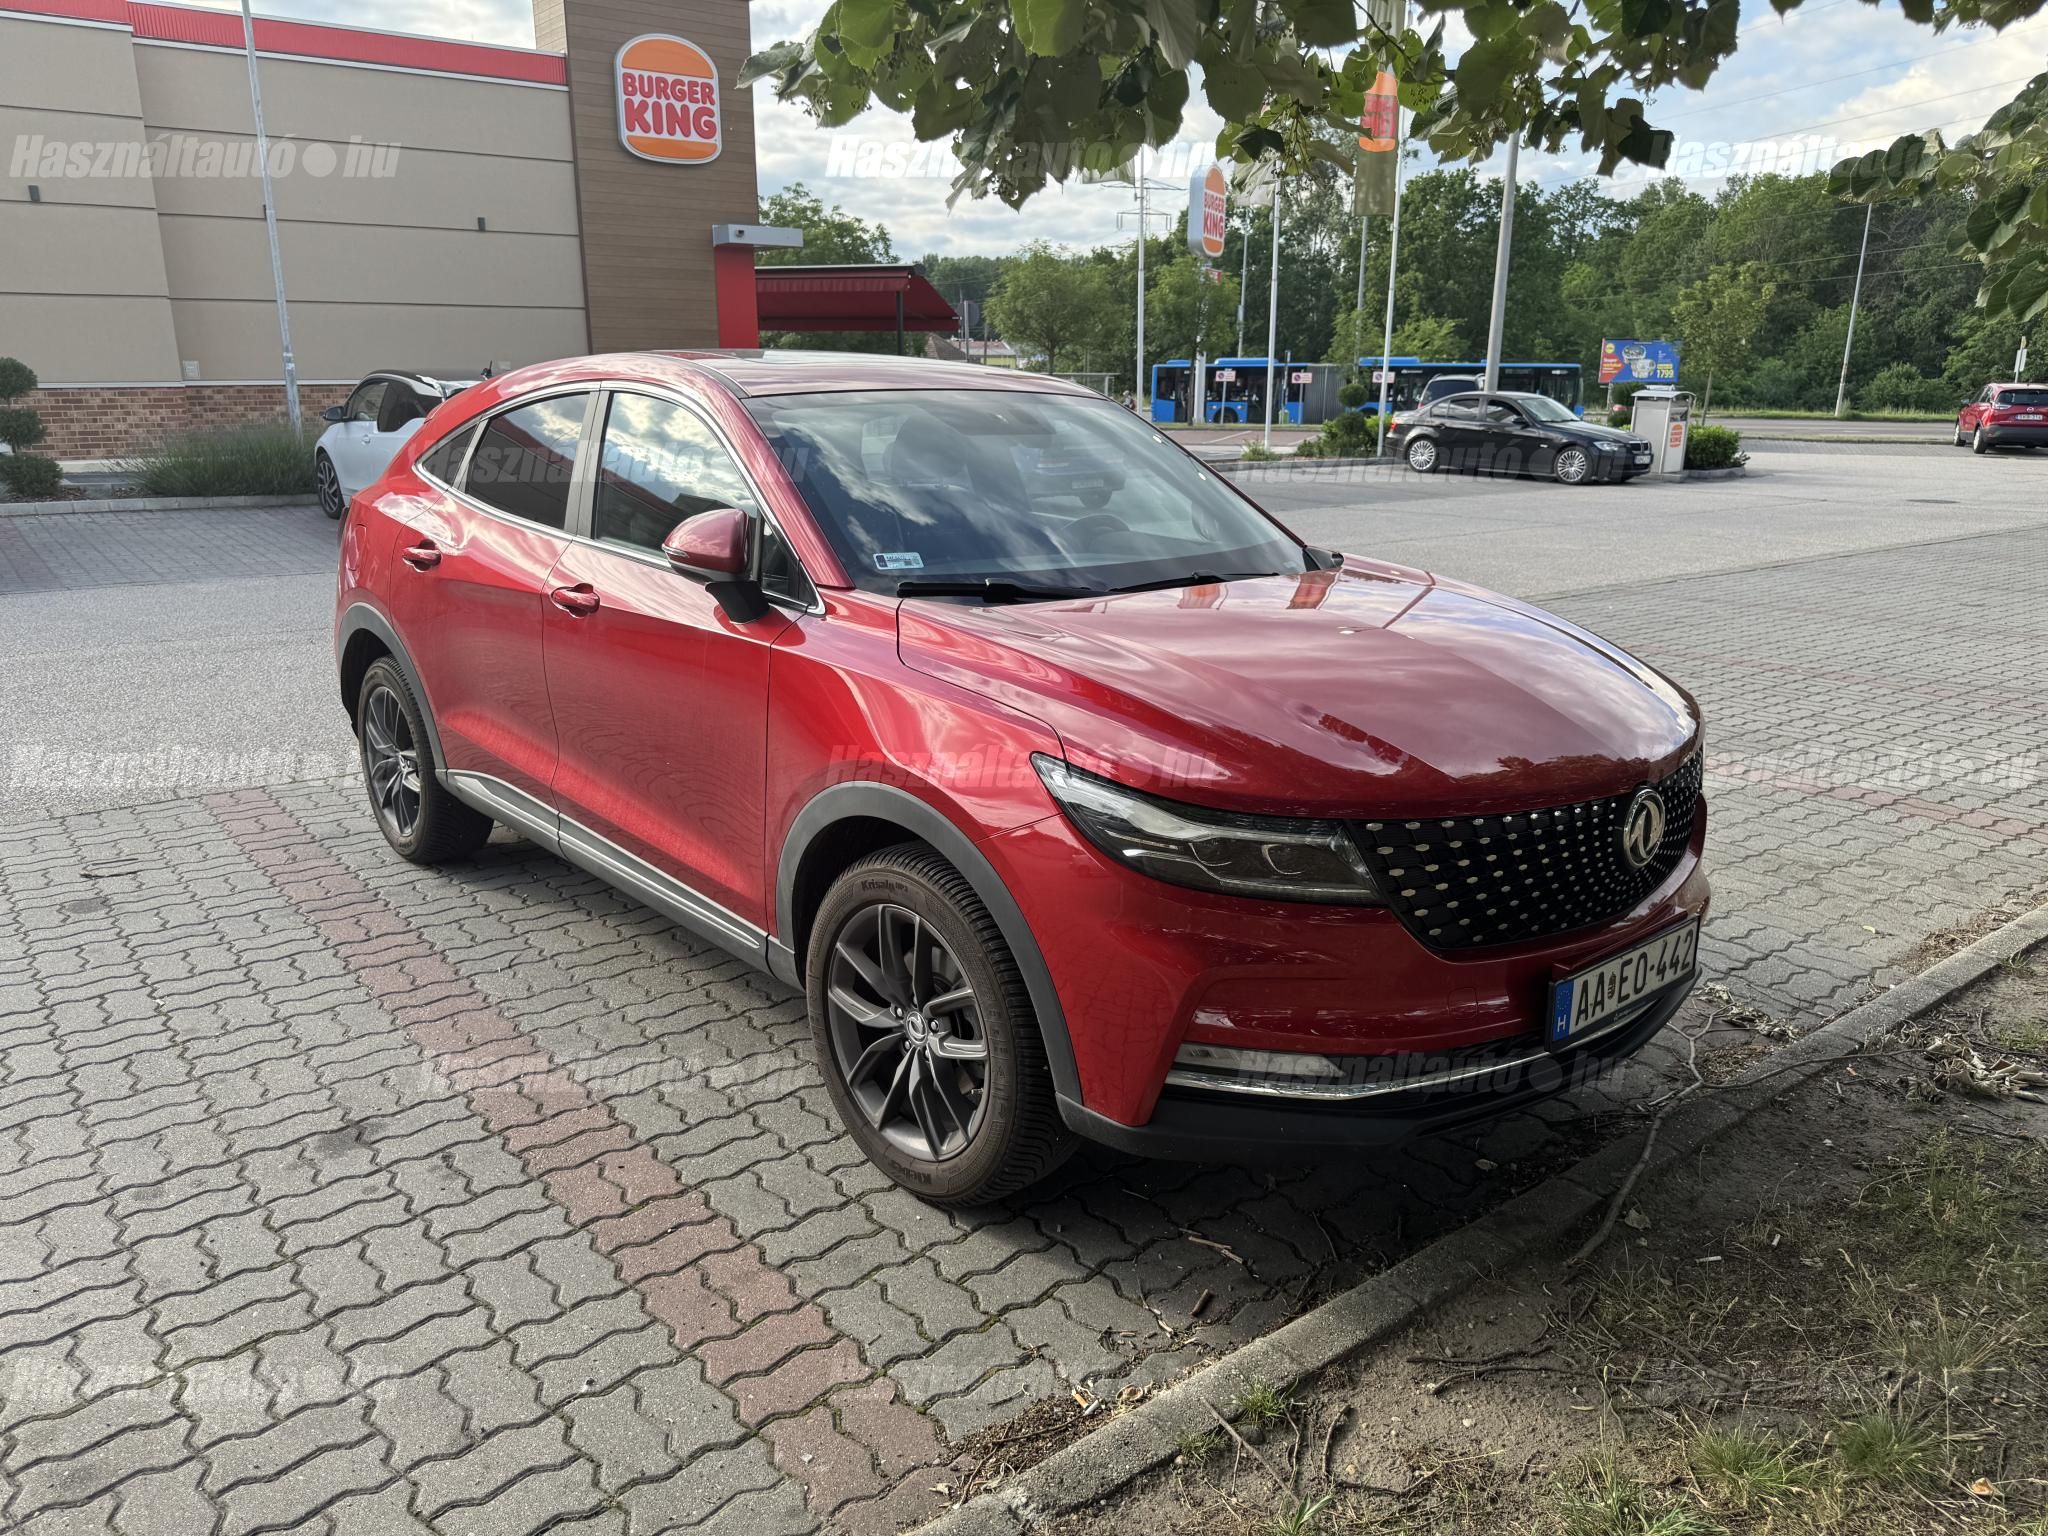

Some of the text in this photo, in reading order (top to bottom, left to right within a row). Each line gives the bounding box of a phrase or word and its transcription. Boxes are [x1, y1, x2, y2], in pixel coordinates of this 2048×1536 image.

[622, 72, 716, 106] BURGER
[624, 97, 718, 140] KING
[1203, 210, 1225, 239] KING
[1557, 1014, 1567, 1033] H
